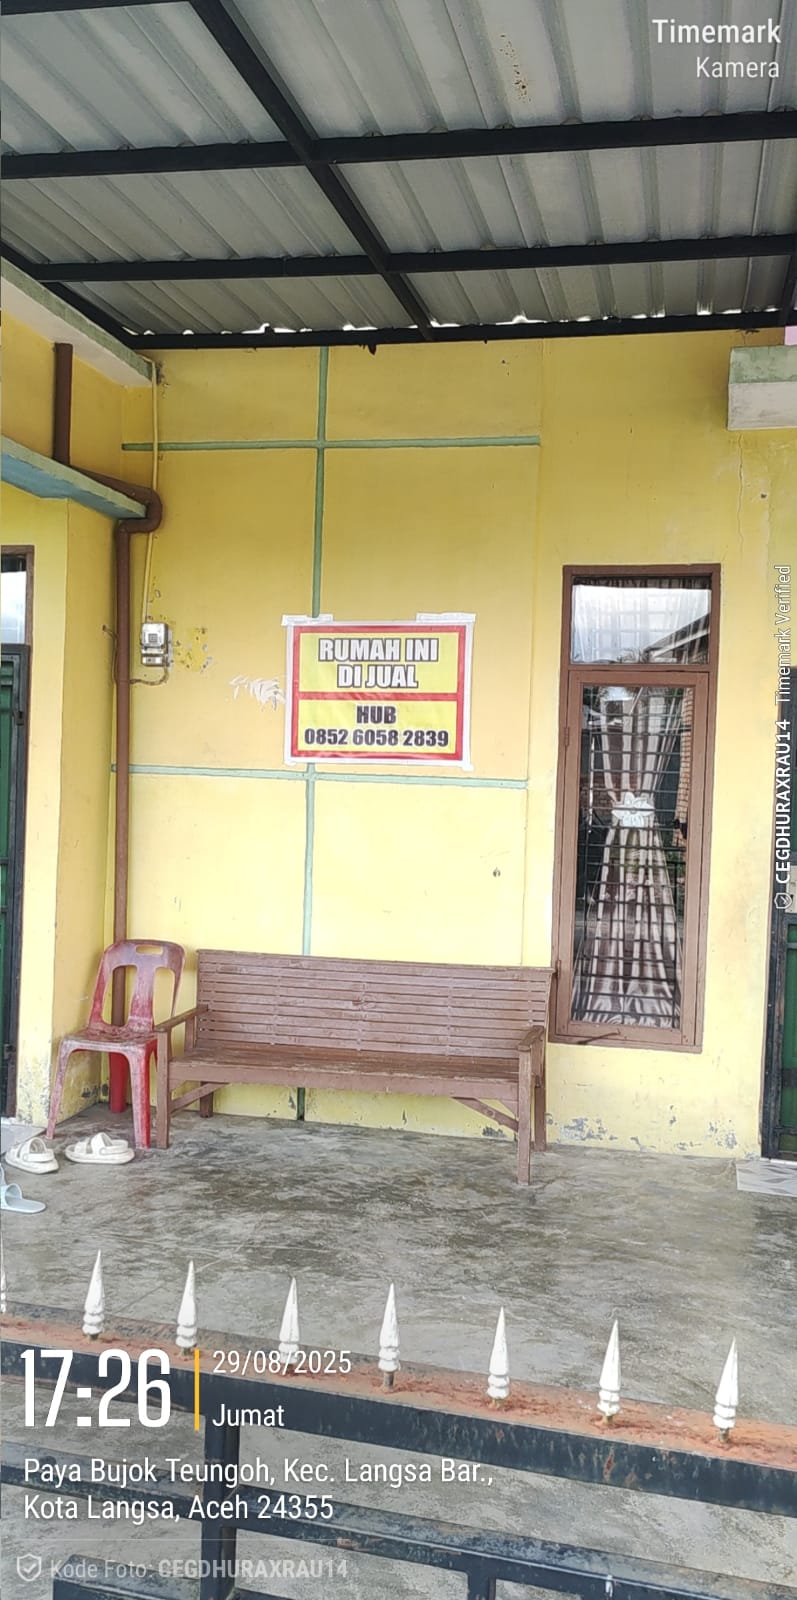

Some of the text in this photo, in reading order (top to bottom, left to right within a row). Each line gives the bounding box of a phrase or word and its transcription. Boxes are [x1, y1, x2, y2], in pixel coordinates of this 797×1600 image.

[318, 638, 439, 662] RUMAH INI
[337, 664, 418, 688] DI JUAL
[356, 706, 396, 724] HUB
[304, 728, 449, 747] 0852 6058 2839
